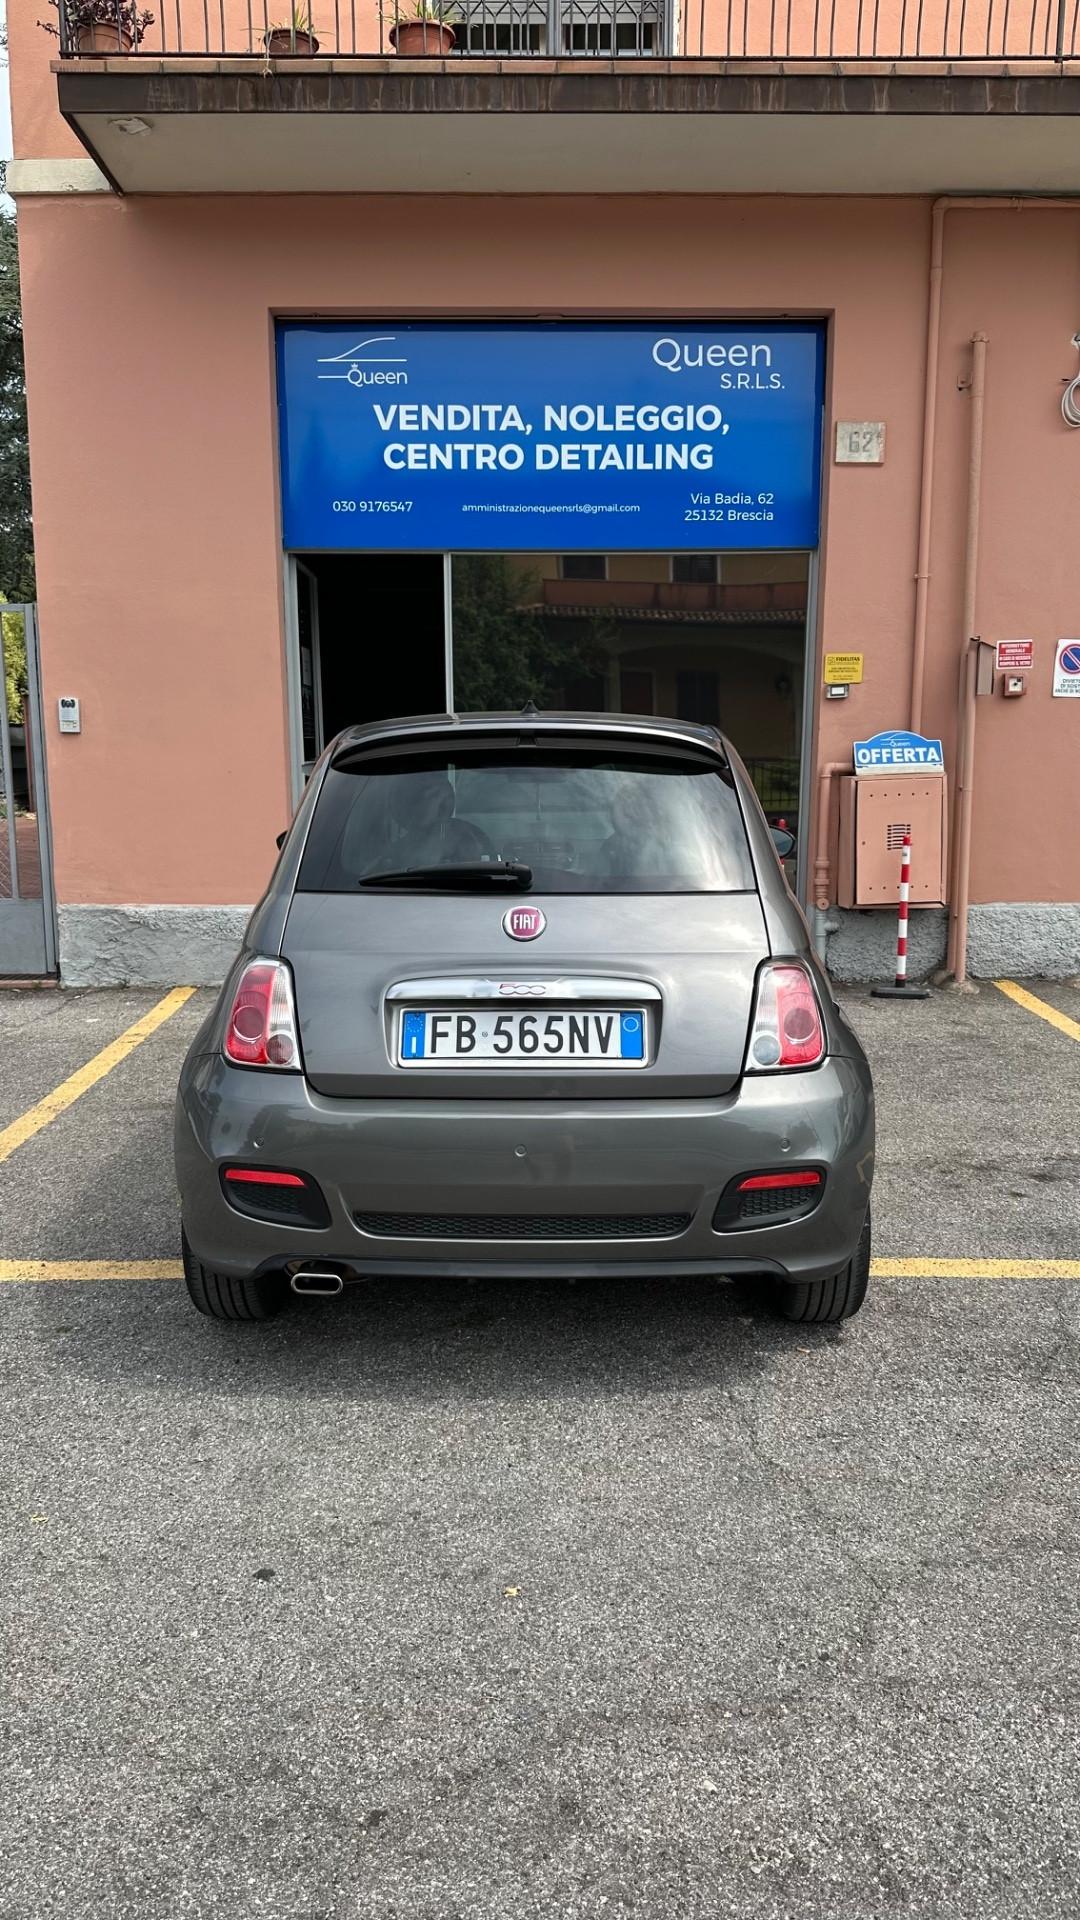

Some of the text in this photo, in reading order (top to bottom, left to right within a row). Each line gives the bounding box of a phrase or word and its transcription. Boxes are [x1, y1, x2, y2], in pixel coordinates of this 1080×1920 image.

[652, 338, 772, 372] Queen
[347, 368, 408, 387] Queen
[720, 373, 785, 389] S.R.L.S.
[373, 404, 730, 435] VENDITA, NOLEGGIO,
[848, 431, 873, 453] 62
[383, 443, 714, 470] CENTRO DETAILING
[332, 501, 413, 512] 030 9176547
[690, 492, 774, 506] Via Badia, 62
[462, 503, 640, 514] amministrazionequeensrls@gmail.com
[684, 510, 774, 521] 25132 Brescia
[857, 747, 940, 764] OFFERTA
[513, 914, 537, 930] FIAT
[498, 983, 547, 995] 500
[430, 1015, 477, 1054] FB
[492, 1015, 614, 1054] 565NV
